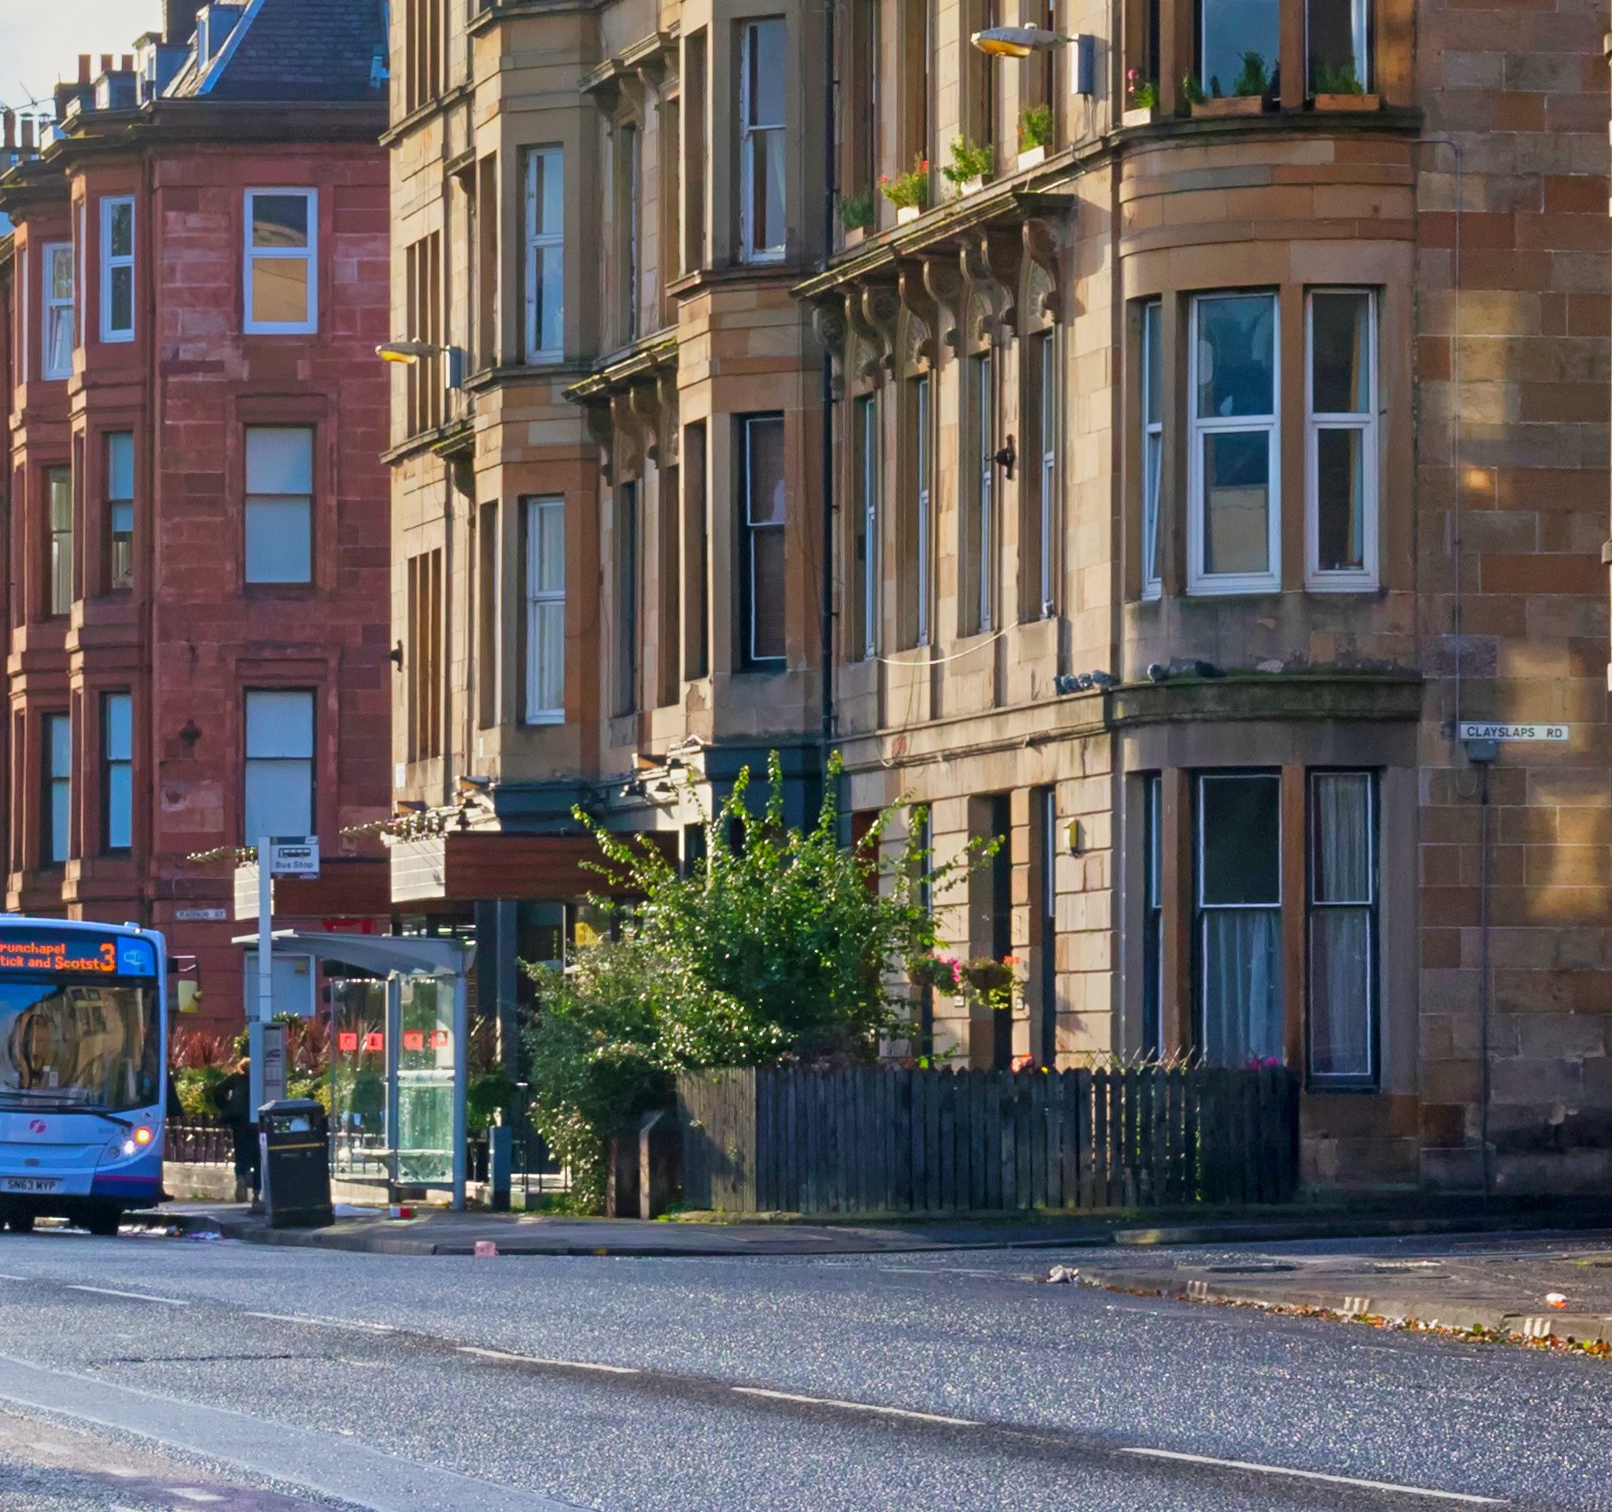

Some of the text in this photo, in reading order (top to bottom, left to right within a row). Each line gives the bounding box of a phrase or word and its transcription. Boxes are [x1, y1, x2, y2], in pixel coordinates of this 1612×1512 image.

[1467, 726, 1563, 738] CLAYSLAPS RD
[275, 861, 314, 870] Bus Stop
[27, 957, 51, 968] and
[99, 942, 116, 972] 3
[7, 1179, 34, 1188] SN63
